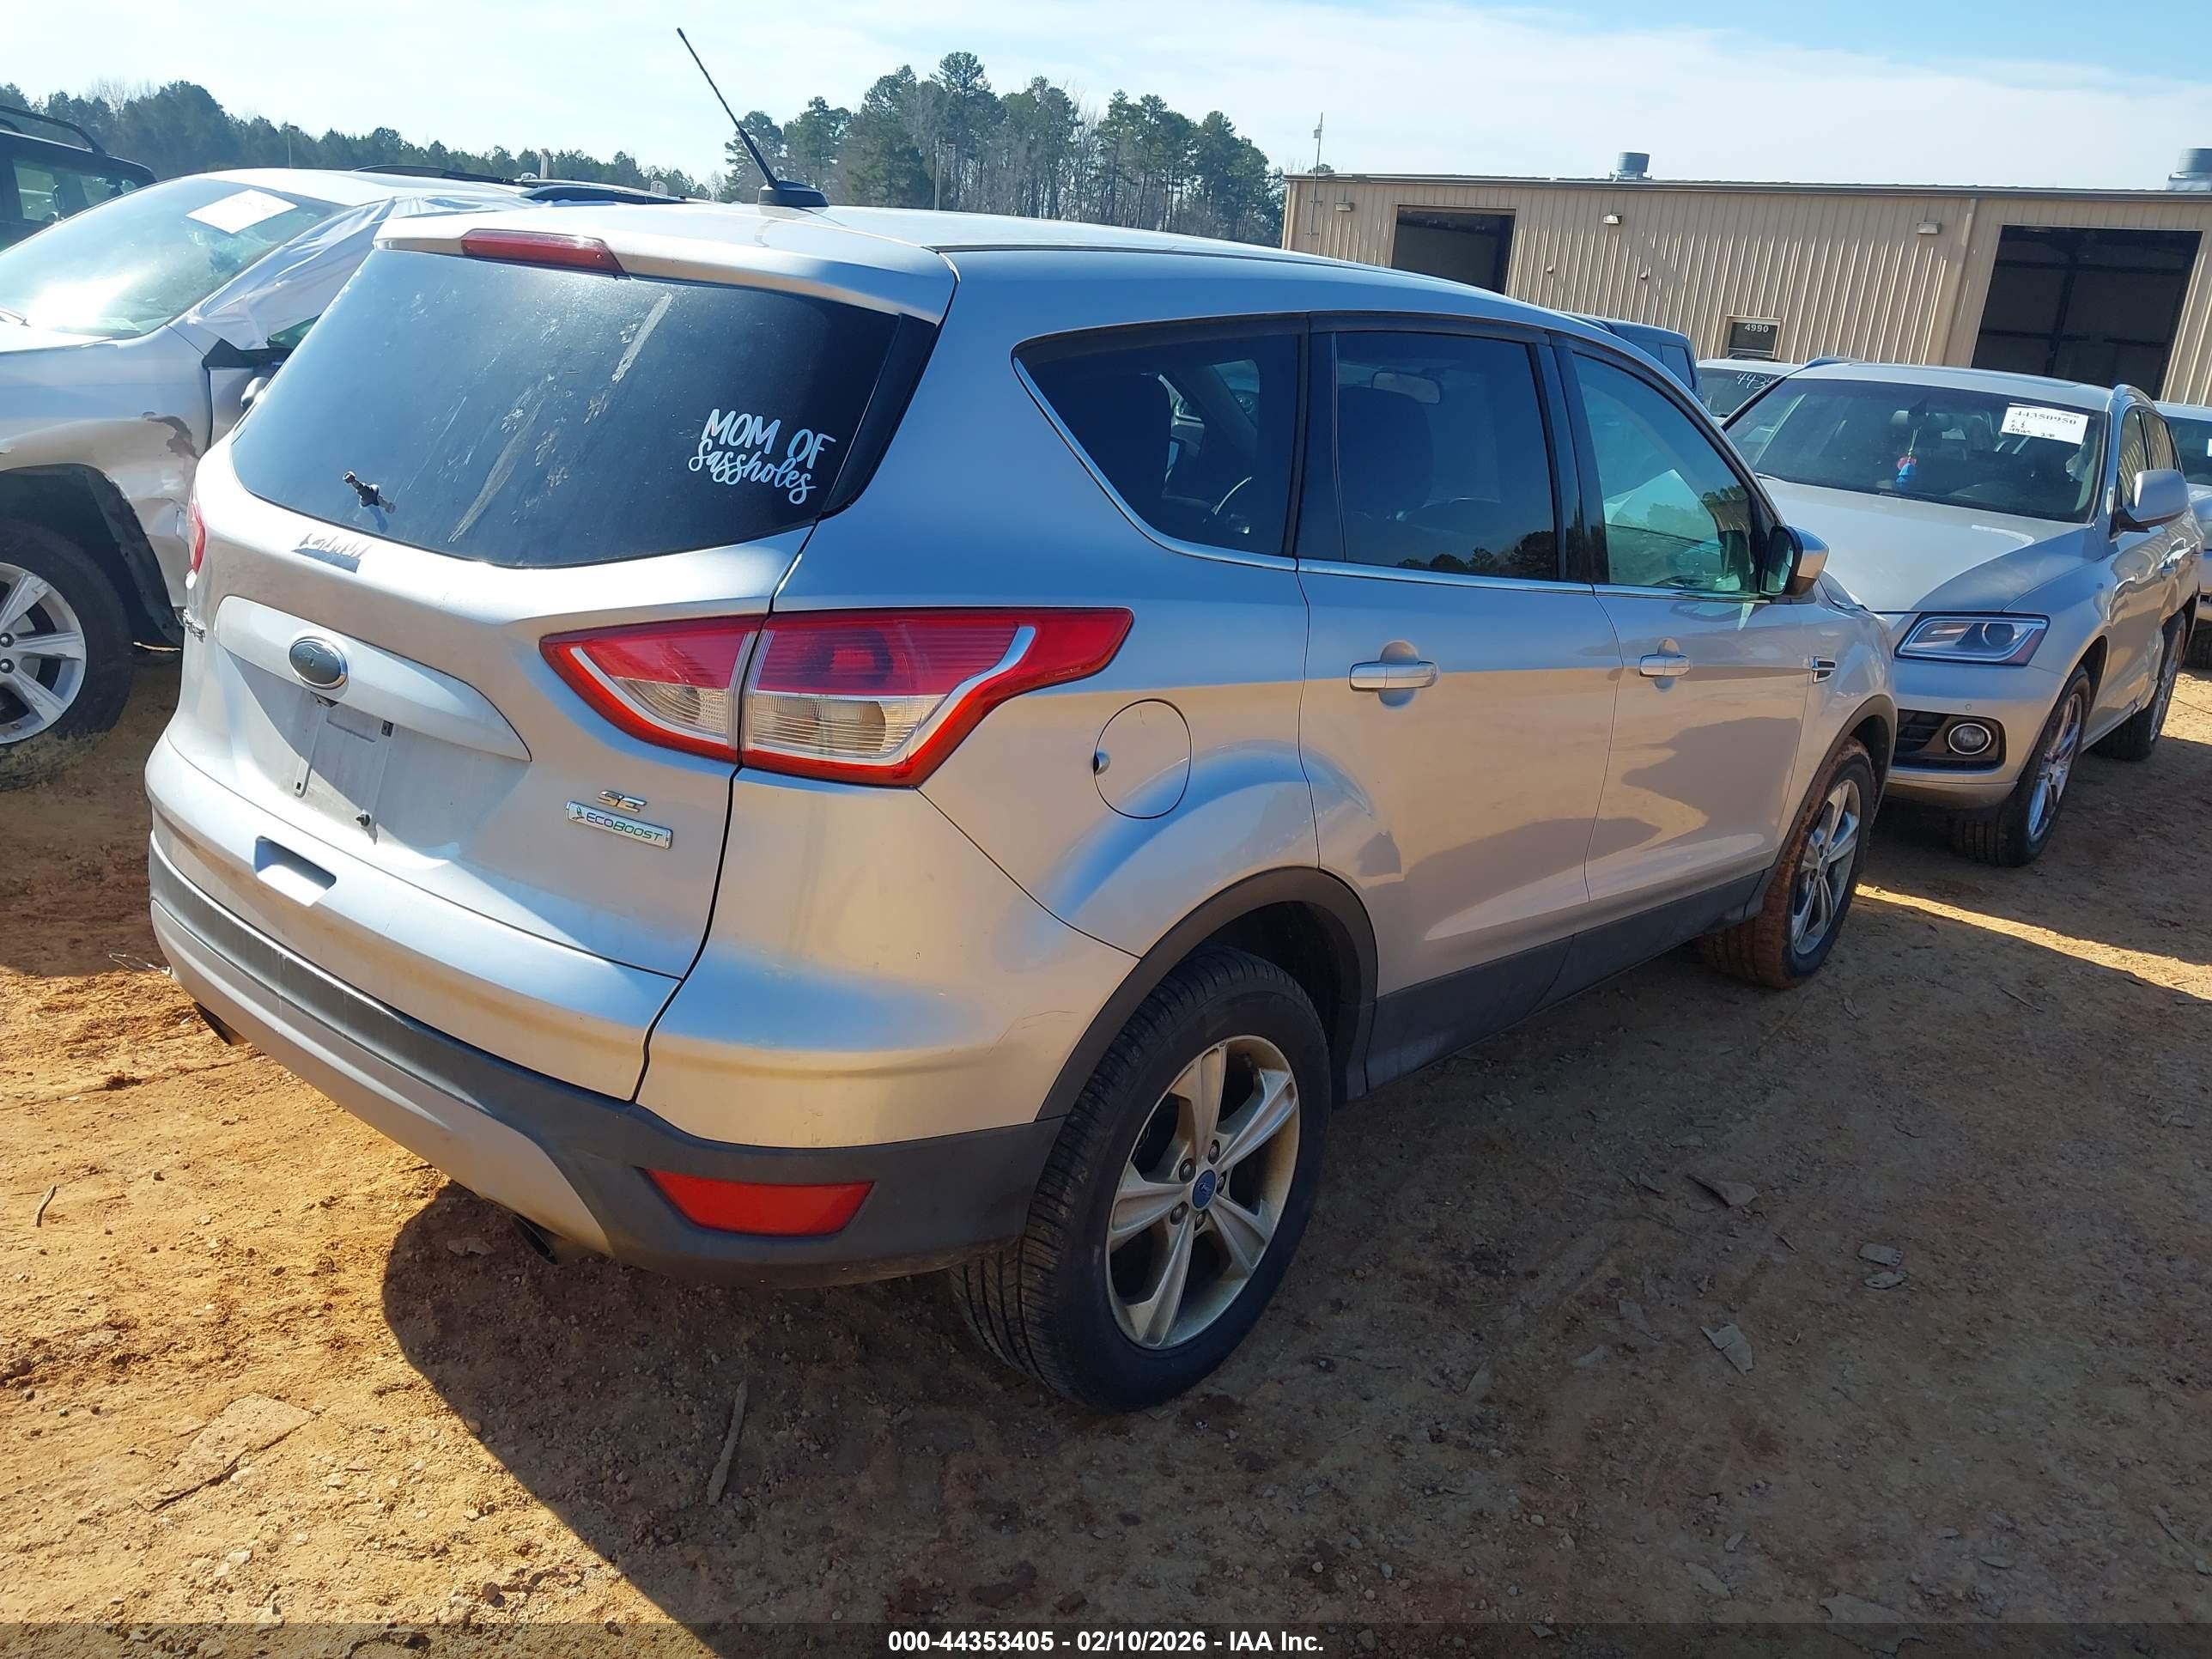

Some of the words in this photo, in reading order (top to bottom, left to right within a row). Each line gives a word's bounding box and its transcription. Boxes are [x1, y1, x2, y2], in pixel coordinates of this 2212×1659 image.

[1744, 323, 1769, 333] 4990
[701, 408, 781, 454] MOM
[787, 428, 836, 469] OF
[688, 438, 817, 505] Sassholes
[596, 789, 647, 813] SE
